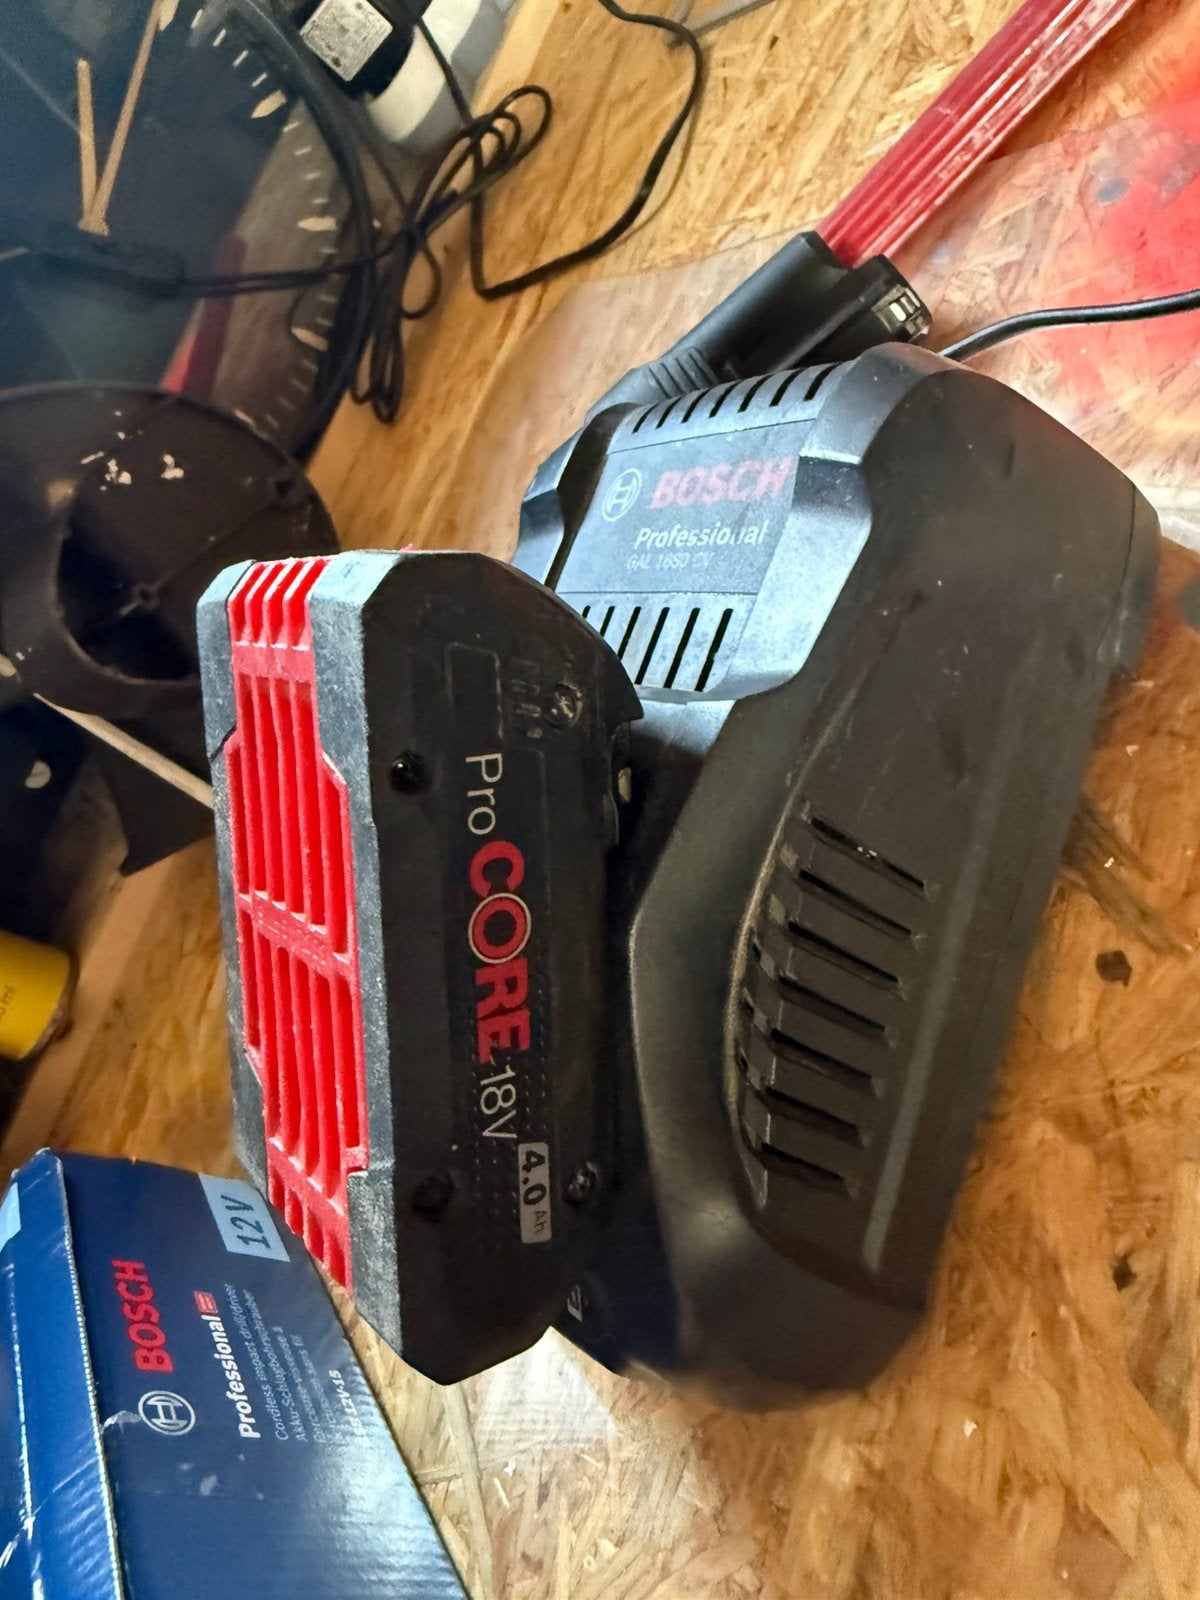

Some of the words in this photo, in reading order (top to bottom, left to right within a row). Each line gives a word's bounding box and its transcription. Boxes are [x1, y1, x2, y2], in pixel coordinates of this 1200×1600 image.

[648, 455, 793, 509] BOSCH
[633, 519, 769, 549] Professional
[522, 1150, 546, 1205] 4.0
[112, 1258, 173, 1372] BOSCH
[224, 1283, 252, 1339] drill/driver
[201, 1314, 261, 1439] Professional
[244, 1341, 267, 1381] impact
[261, 1384, 289, 1440] Cordless
[328, 1369, 358, 1416] 12V-15
